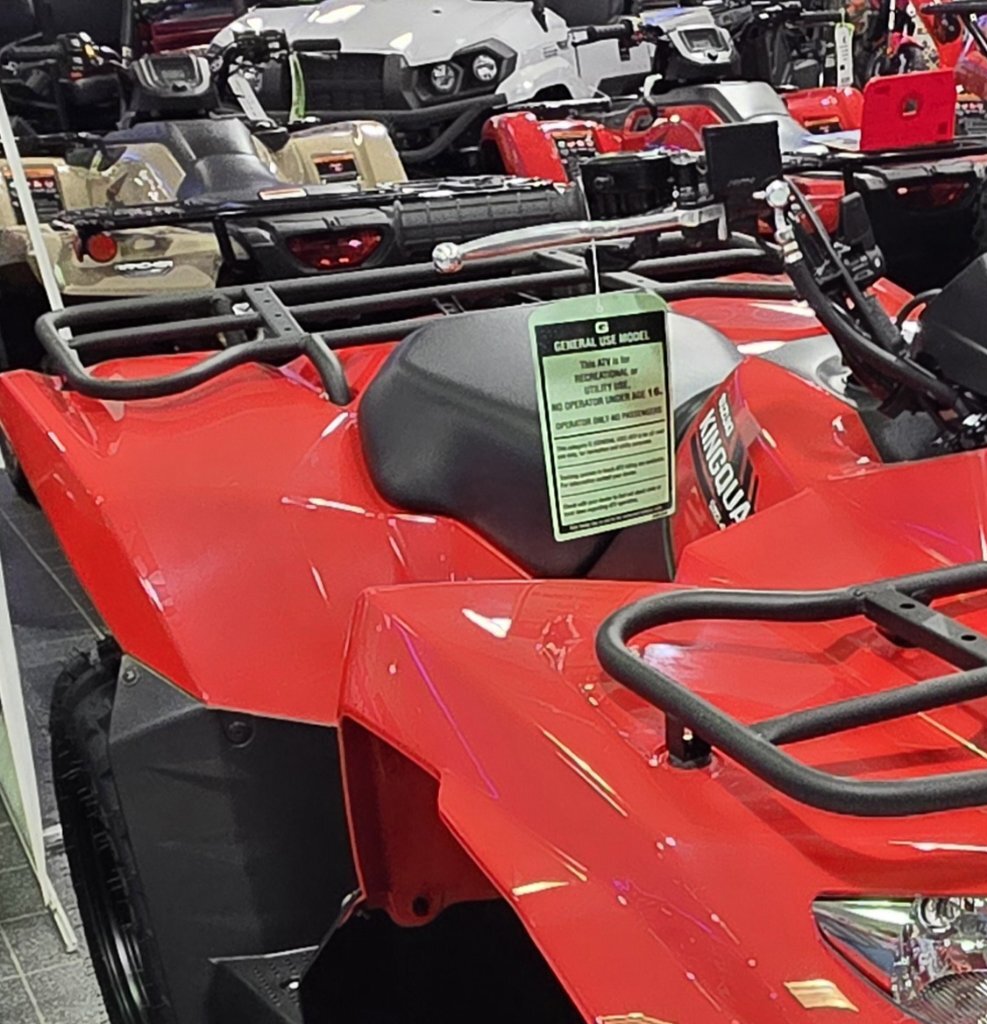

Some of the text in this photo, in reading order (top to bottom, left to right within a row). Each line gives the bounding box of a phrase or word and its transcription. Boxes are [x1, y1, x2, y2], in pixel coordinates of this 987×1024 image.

[553, 330, 650, 352] GENERAL USE MODEL
[699, 407, 751, 524] KINGQUA
